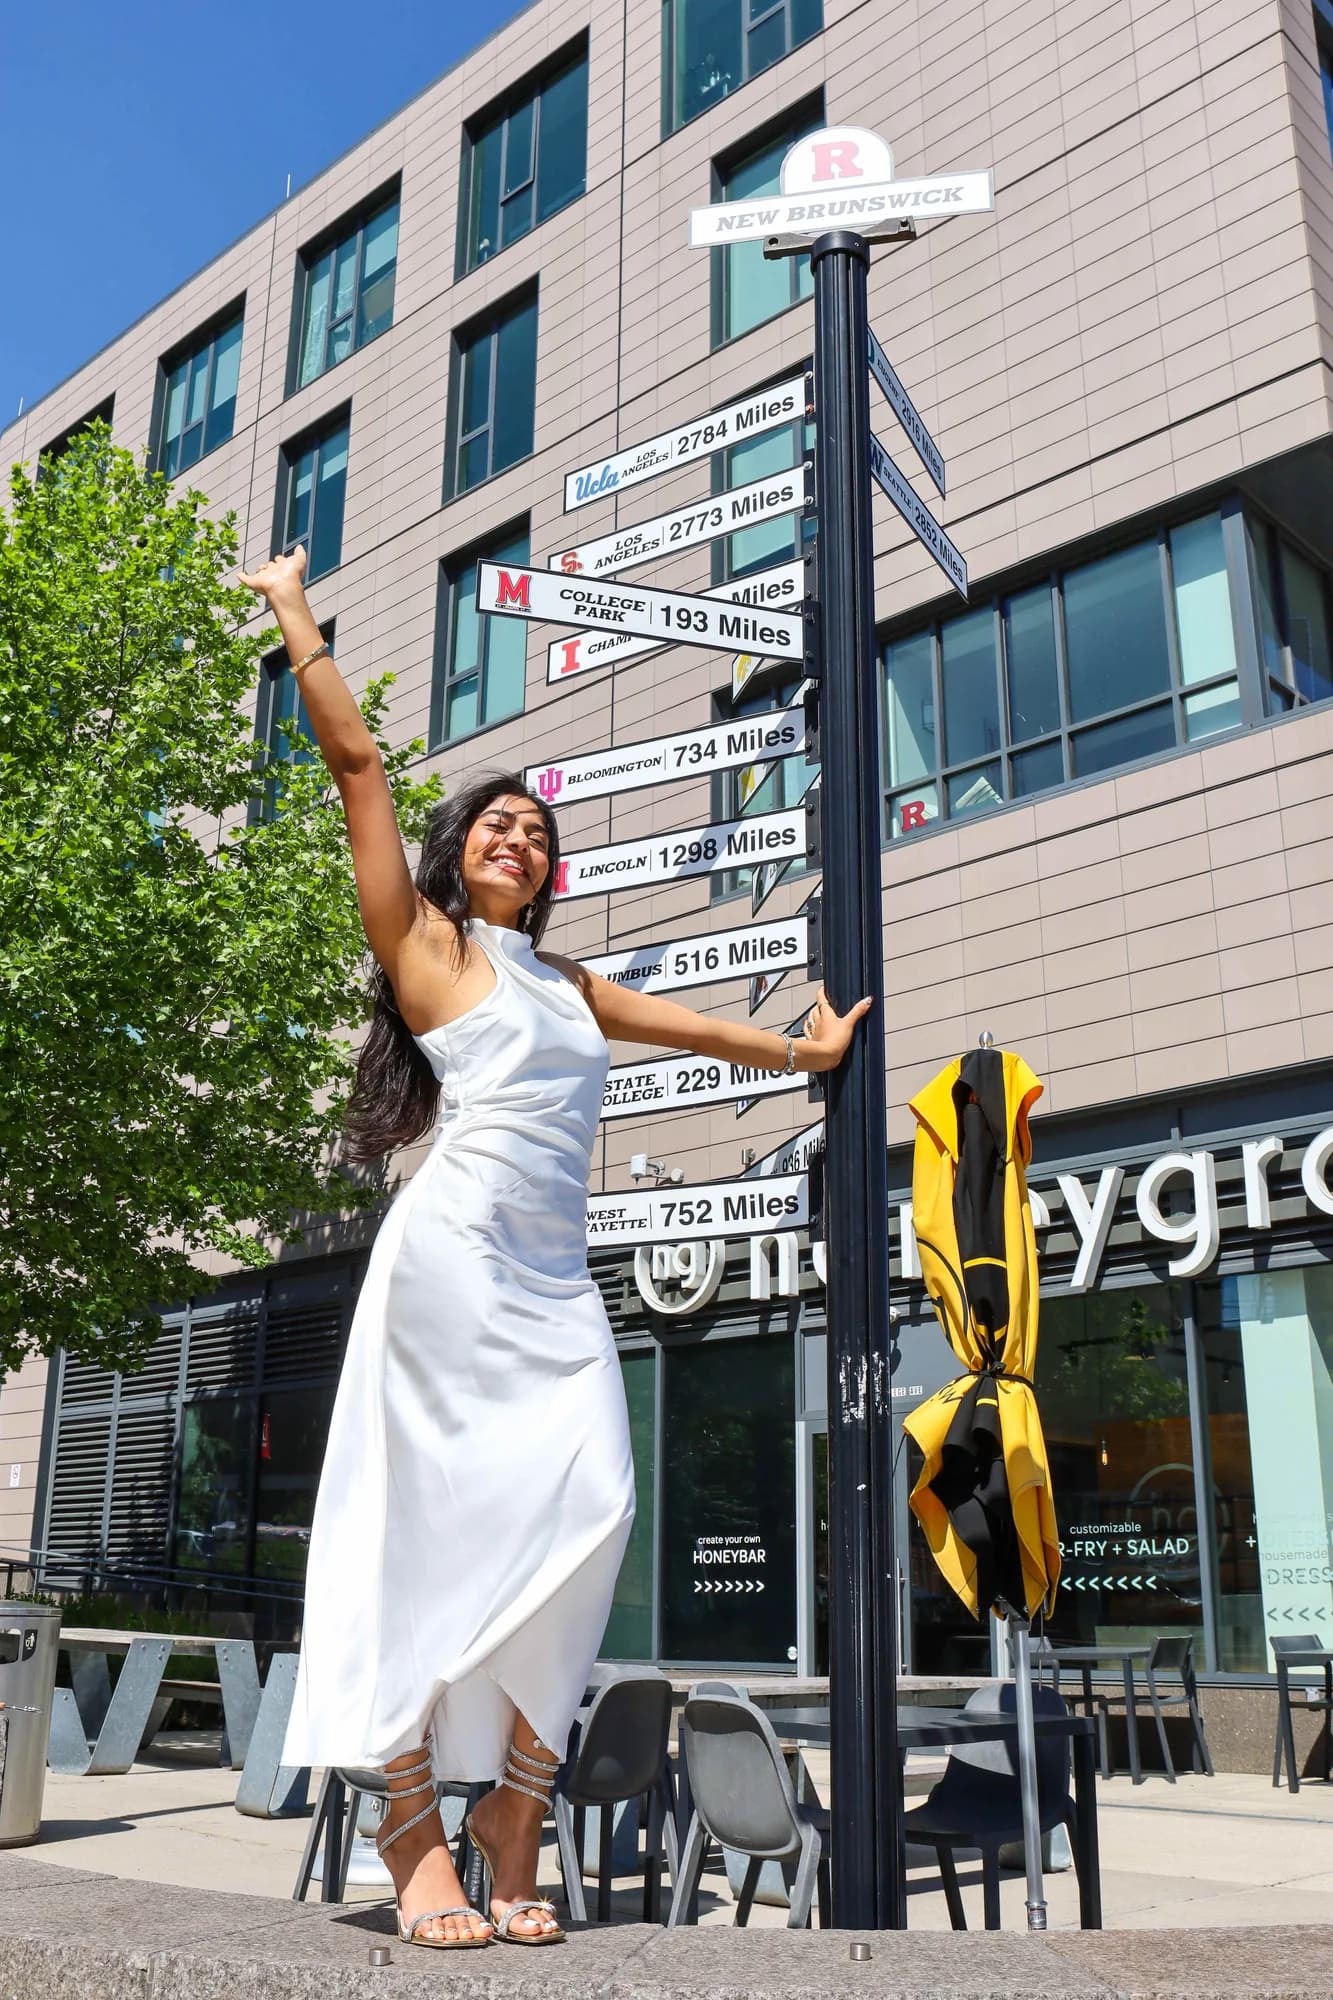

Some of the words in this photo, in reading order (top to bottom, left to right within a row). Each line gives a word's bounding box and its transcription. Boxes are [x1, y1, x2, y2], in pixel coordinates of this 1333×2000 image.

[810, 140, 864, 182] R
[715, 209, 781, 232] NEW
[786, 186, 965, 222] BRUNSWICK
[678, 420, 728, 456] 2784
[735, 395, 794, 431] Miles
[901, 399, 921, 443] 2916
[921, 434, 942, 482] Miles
[621, 452, 669, 478] ANGELES
[636, 449, 657, 463] LOS
[670, 508, 724, 542] 2773
[731, 485, 794, 519] Miles
[883, 466, 912, 509] SEATTLE
[915, 506, 938, 547] 2852
[939, 540, 964, 583] Miles
[594, 539, 660, 569] ANGELES
[615, 534, 643, 551] LOS
[496, 570, 532, 607] M
[560, 589, 646, 612] COLLEGE
[731, 578, 795, 604] Miles
[574, 604, 626, 622] PARK
[660, 604, 709, 633] 193
[718, 614, 791, 646] Miles
[567, 756, 662, 785] BLOOMINGTON
[673, 739, 718, 767] 734
[726, 723, 796, 756] Miles
[901, 800, 928, 832] R
[578, 855, 648, 879] LINCOLN
[658, 838, 717, 869] 1298
[726, 826, 796, 856] Miles
[674, 946, 719, 975] 516
[728, 936, 798, 966] Miles
[604, 1073, 656, 1093] STATE
[676, 1065, 721, 1094] 229
[602, 1086, 665, 1107] OLLEGE
[586, 1218, 648, 1233] AYETTE
[587, 1208, 627, 1222] WEST
[660, 1200, 713, 1229] 752
[723, 1193, 799, 1222] Miles
[698, 1536, 724, 1545] create
[725, 1536, 743, 1546] your
[744, 1535, 761, 1543] own
[1069, 1522, 1142, 1535] customizable
[693, 1549, 766, 1564] HONEYBAR
[1127, 1538, 1190, 1557] SALAD
